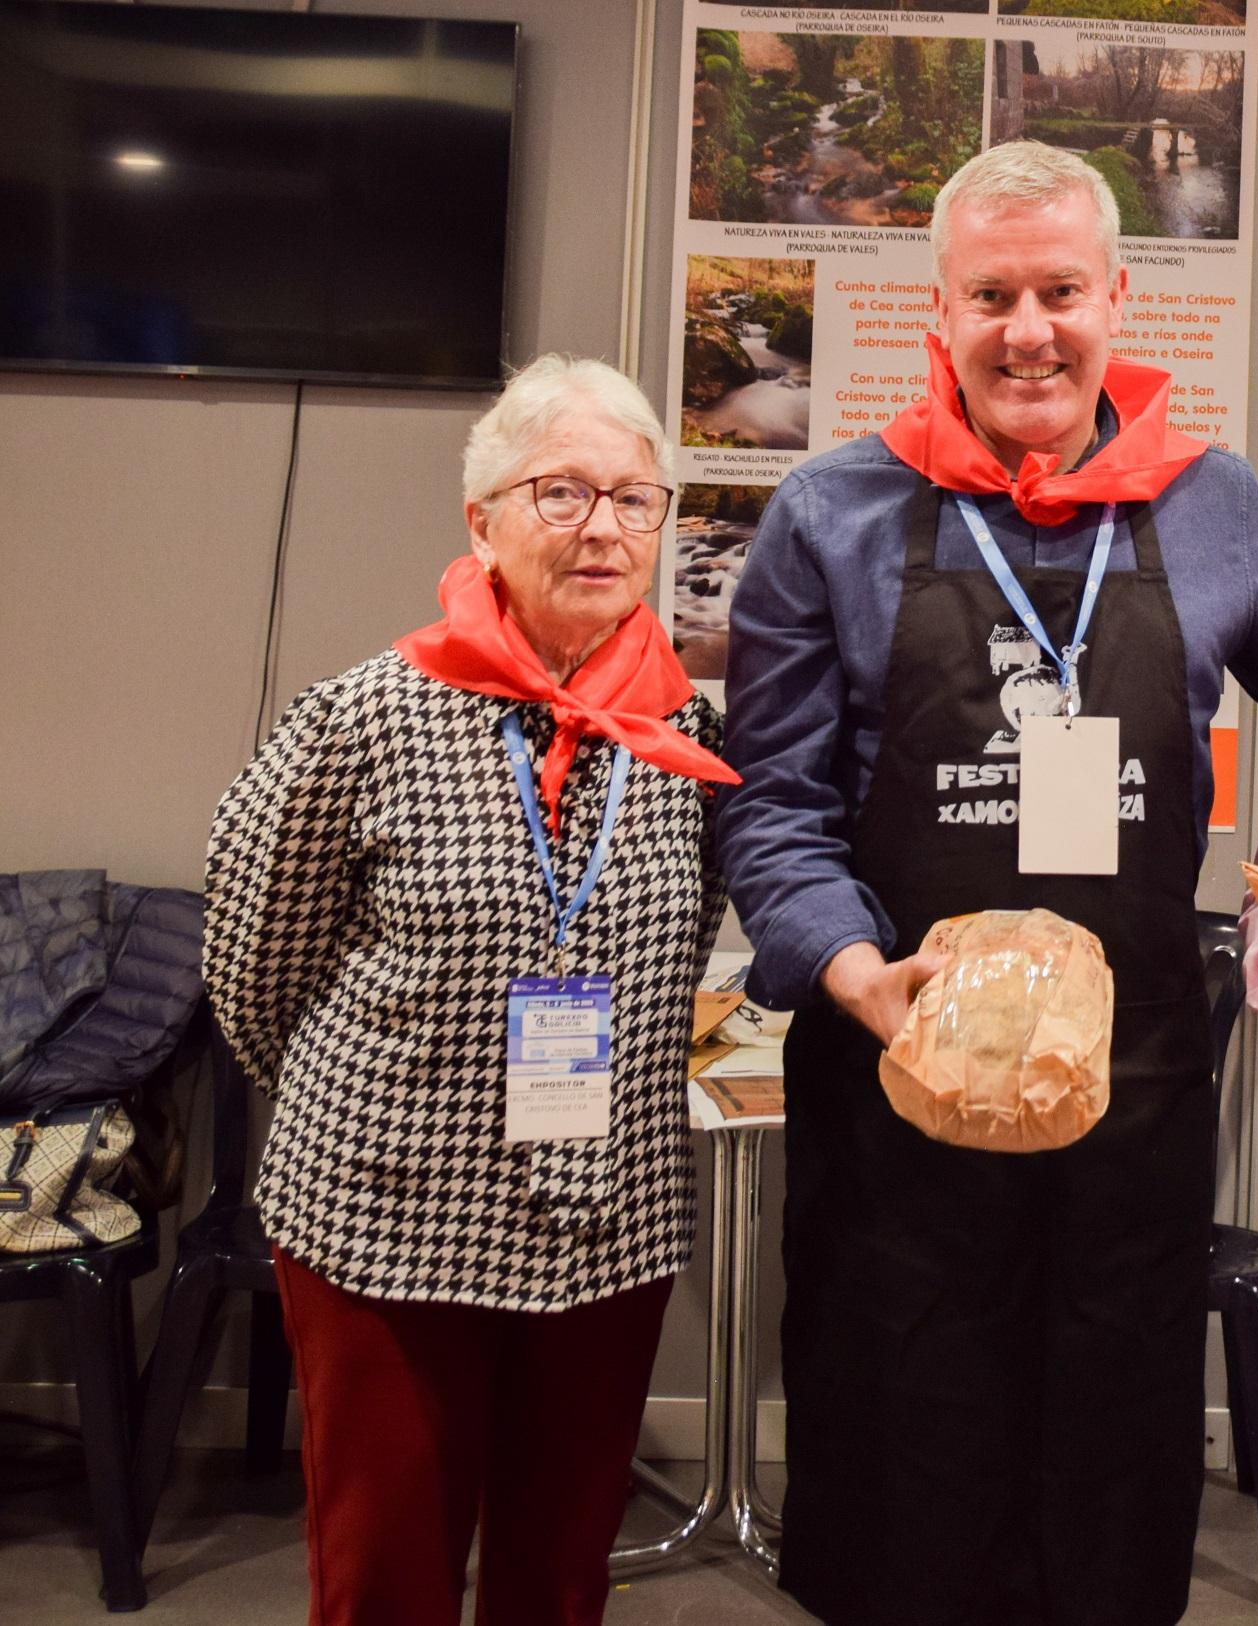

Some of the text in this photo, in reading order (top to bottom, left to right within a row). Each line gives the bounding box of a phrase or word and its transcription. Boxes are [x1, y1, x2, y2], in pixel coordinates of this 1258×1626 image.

[741, 9, 777, 18] CASCADA
[780, 11, 791, 19] NO
[807, 11, 835, 20] OSEIRA
[840, 12, 877, 21] CASCADA
[878, 13, 889, 21] EN
[890, 14, 899, 22] EL
[915, 14, 945, 23] OSEIRA
[796, 22, 889, 34] (PARROQUIA DE OSEIRA)
[1040, 19, 1083, 29] CASCADAS
[1084, 20, 1095, 29] EN
[1168, 24, 1210, 36] CASCADAS
[1211, 27, 1221, 36] EN
[1076, 31, 1125, 43] (PARROQUIA
[1126, 34, 1136, 43] DE
[724, 227, 932, 243] NATUREZA VIVA EN VALES NATURALEZA VIVA EN VAL
[786, 243, 879, 256] (PARROQUIA DE VALES)
[1121, 242, 1152, 252] FACUNDO
[1188, 244, 1237, 254] PRIVILEGIADOS
[1126, 254, 1143, 265] SAN
[1144, 255, 1185, 268] FACUNDO)
[835, 280, 932, 294] Cunha climatol
[849, 299, 865, 310] de
[870, 299, 894, 311] Cea
[1138, 292, 1154, 303] de
[1158, 292, 1182, 304] San
[1186, 294, 1236, 306] Cristovo
[1131, 310, 1167, 322] sobre
[1171, 312, 1200, 323] todo
[1204, 314, 1221, 324] na
[855, 319, 890, 331] parte
[894, 320, 932, 331] norte.
[1141, 329, 1150, 339] e
[1154, 328, 1177, 340] ríos
[1181, 330, 1214, 341] onde
[853, 337, 919, 349] sobresaen
[1111, 347, 1214, 360] enteiro e Oseira
[850, 372, 875, 384] Con
[879, 375, 903, 385] una
[1170, 383, 1215, 396] de San
[835, 390, 928, 404] Cristovo de Ce
[841, 409, 890, 421] todo en
[1192, 403, 1228, 415] sobre
[832, 426, 855, 439] ríos
[1214, 424, 1222, 436] y
[693, 453, 720, 462] REGATO
[761, 455, 770, 463] EN
[703, 467, 783, 479] (PARROQUIA DE OSEIRA)
[937, 762, 1020, 790] FEST
[937, 799, 1020, 825] XAMO
